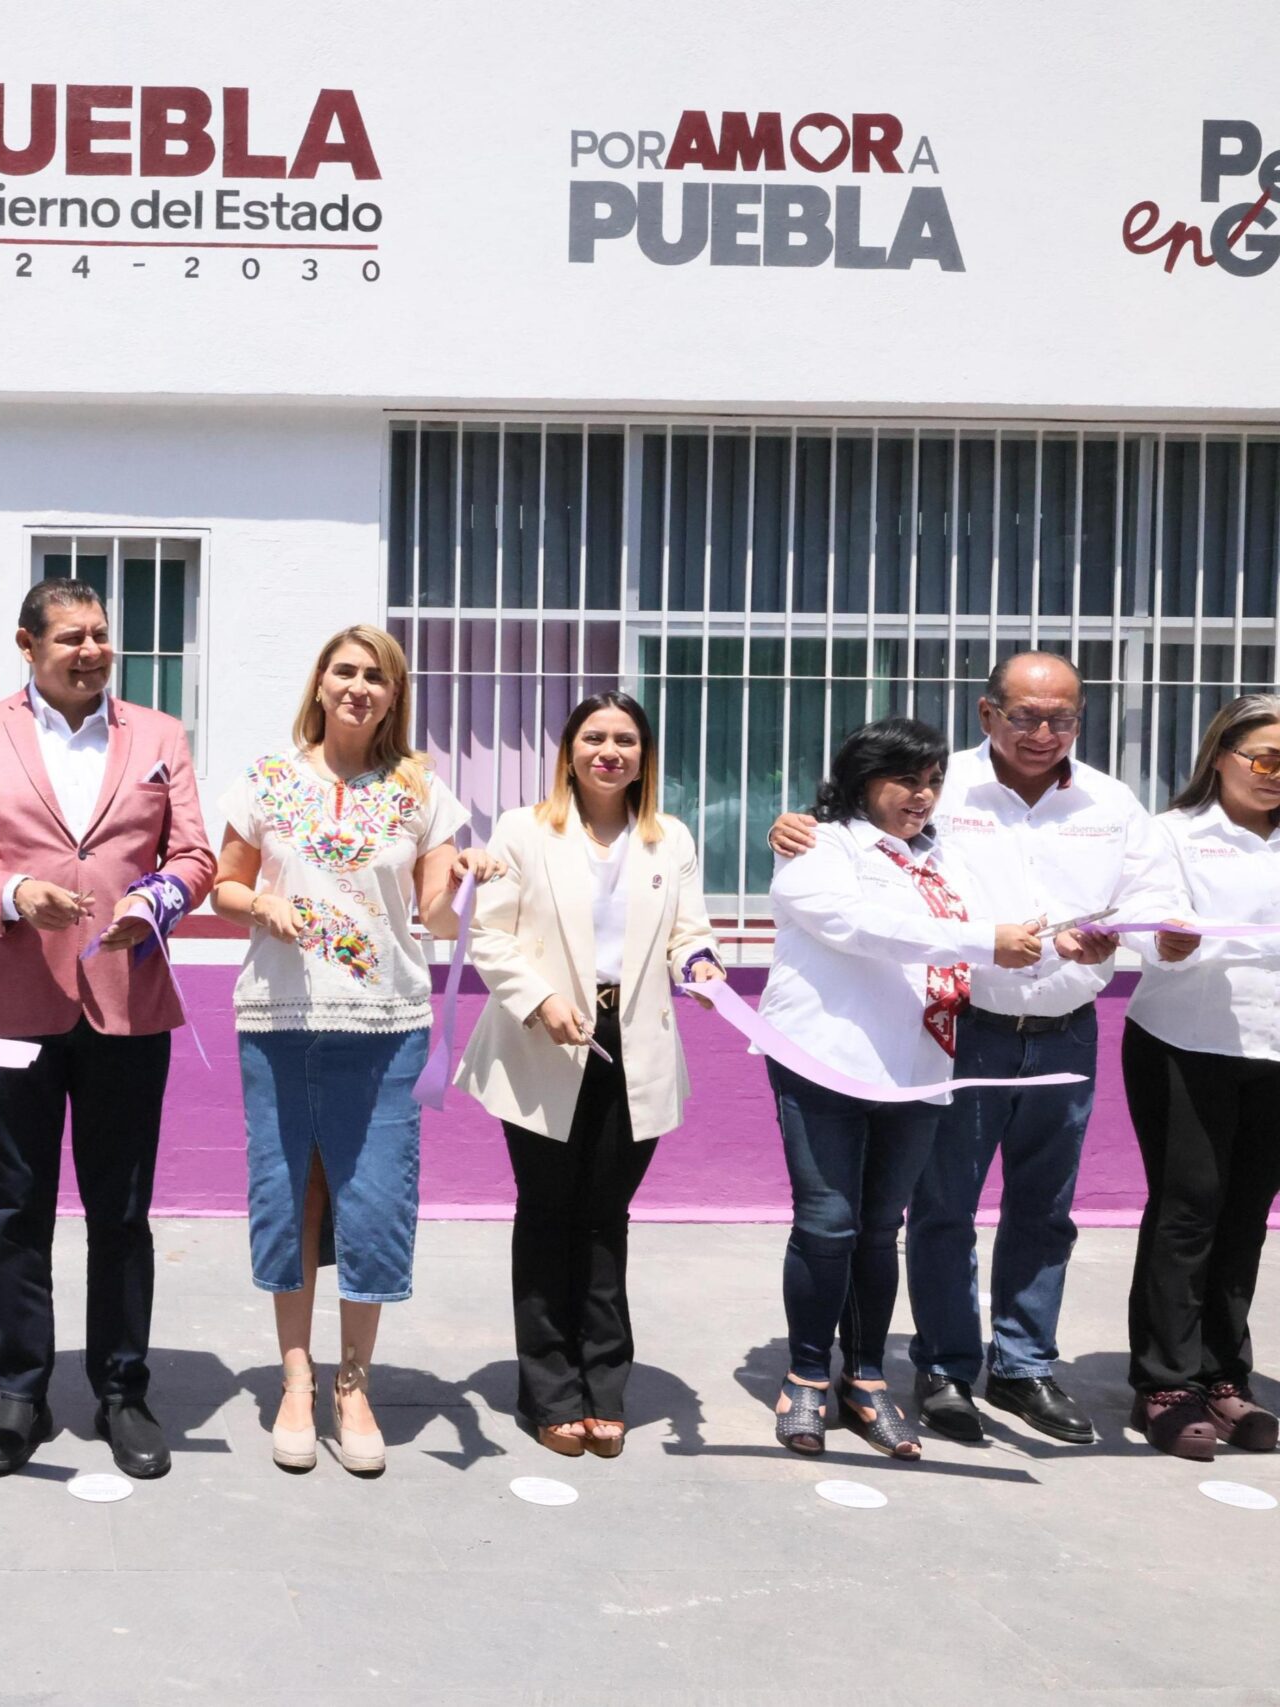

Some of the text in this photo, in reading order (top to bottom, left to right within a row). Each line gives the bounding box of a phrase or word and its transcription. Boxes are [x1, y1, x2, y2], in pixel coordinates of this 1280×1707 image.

[571, 110, 939, 174] POR AMOR A
[131, 190, 203, 230] del
[216, 190, 382, 233] Estado
[569, 180, 966, 272] PUEBLA
[952, 817, 995, 827] PUEBLA
